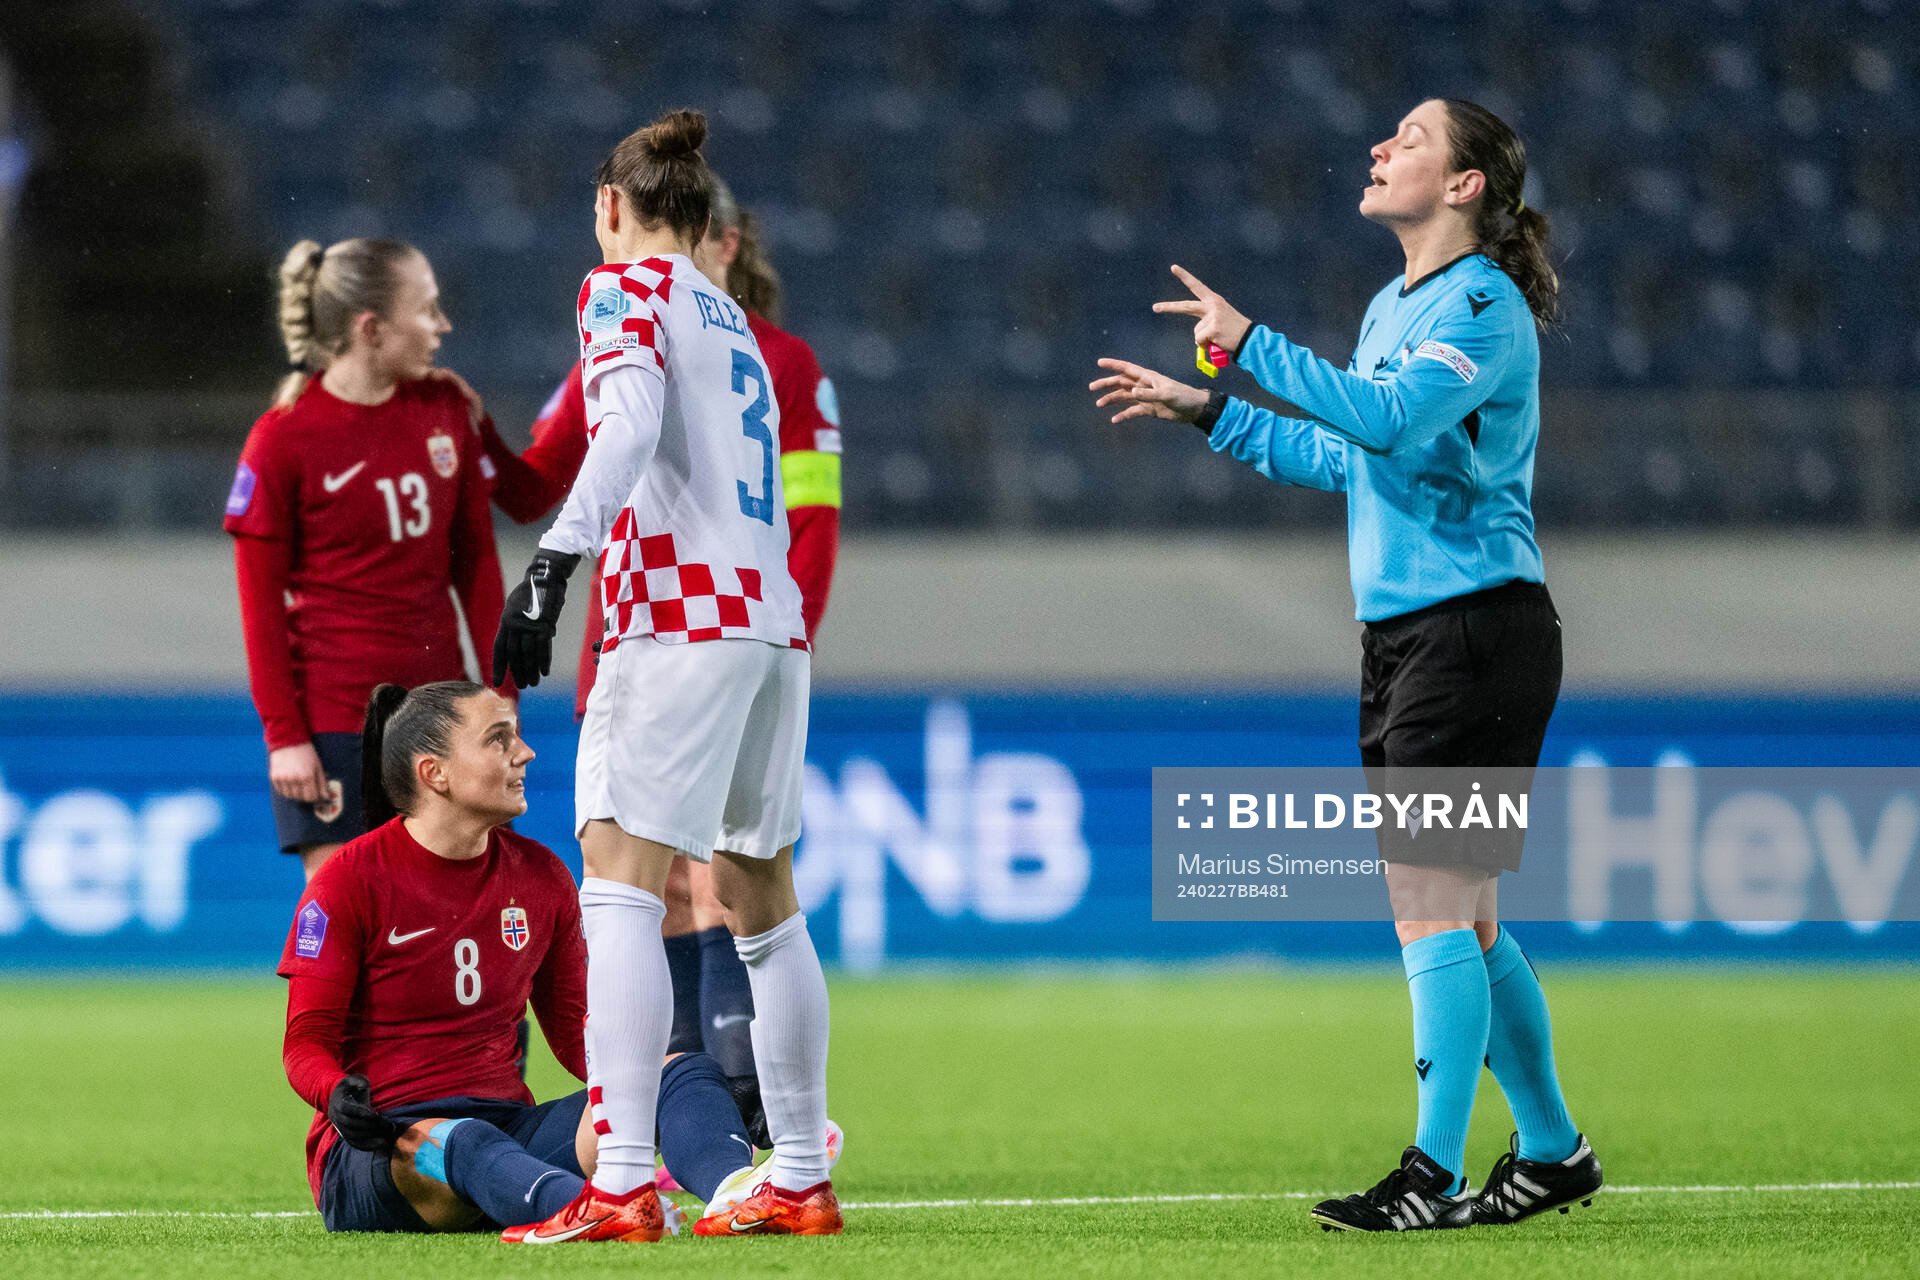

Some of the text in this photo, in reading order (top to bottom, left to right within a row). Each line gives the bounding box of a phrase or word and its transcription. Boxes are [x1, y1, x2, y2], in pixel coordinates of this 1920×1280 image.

[730, 347, 774, 527] 3
[375, 472, 432, 542] 13
[454, 938, 481, 1006] 8
